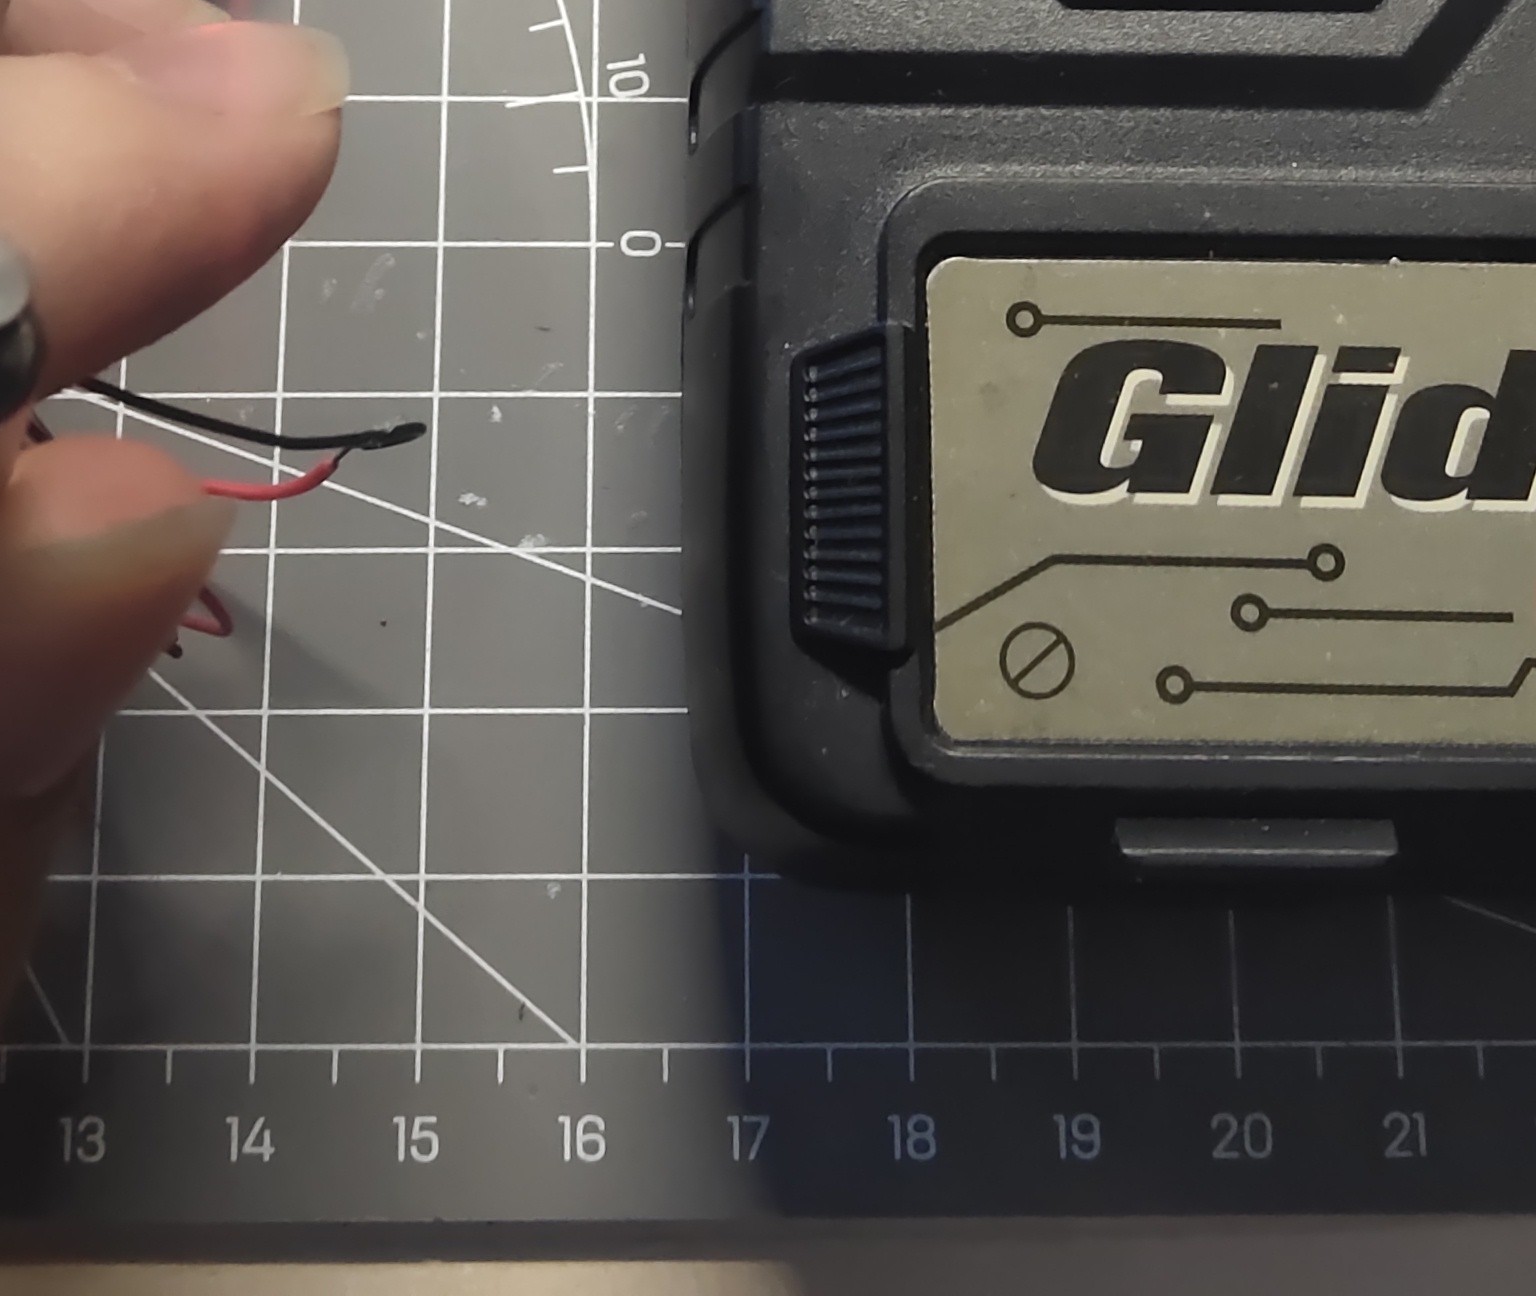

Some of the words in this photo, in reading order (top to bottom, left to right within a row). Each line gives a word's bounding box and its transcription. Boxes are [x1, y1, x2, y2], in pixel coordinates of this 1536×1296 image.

[607, 52, 651, 98] 10
[619, 231, 663, 257] 0
[59, 1115, 107, 1163] 13
[225, 1115, 276, 1163] 14
[392, 1115, 440, 1163] 15
[558, 1115, 607, 1163] 16
[727, 1115, 771, 1163] 17
[887, 1115, 937, 1162] 18
[1054, 1113, 1102, 1161] 19
[1210, 1113, 1274, 1161] 20
[1382, 1112, 1430, 1159] 21
